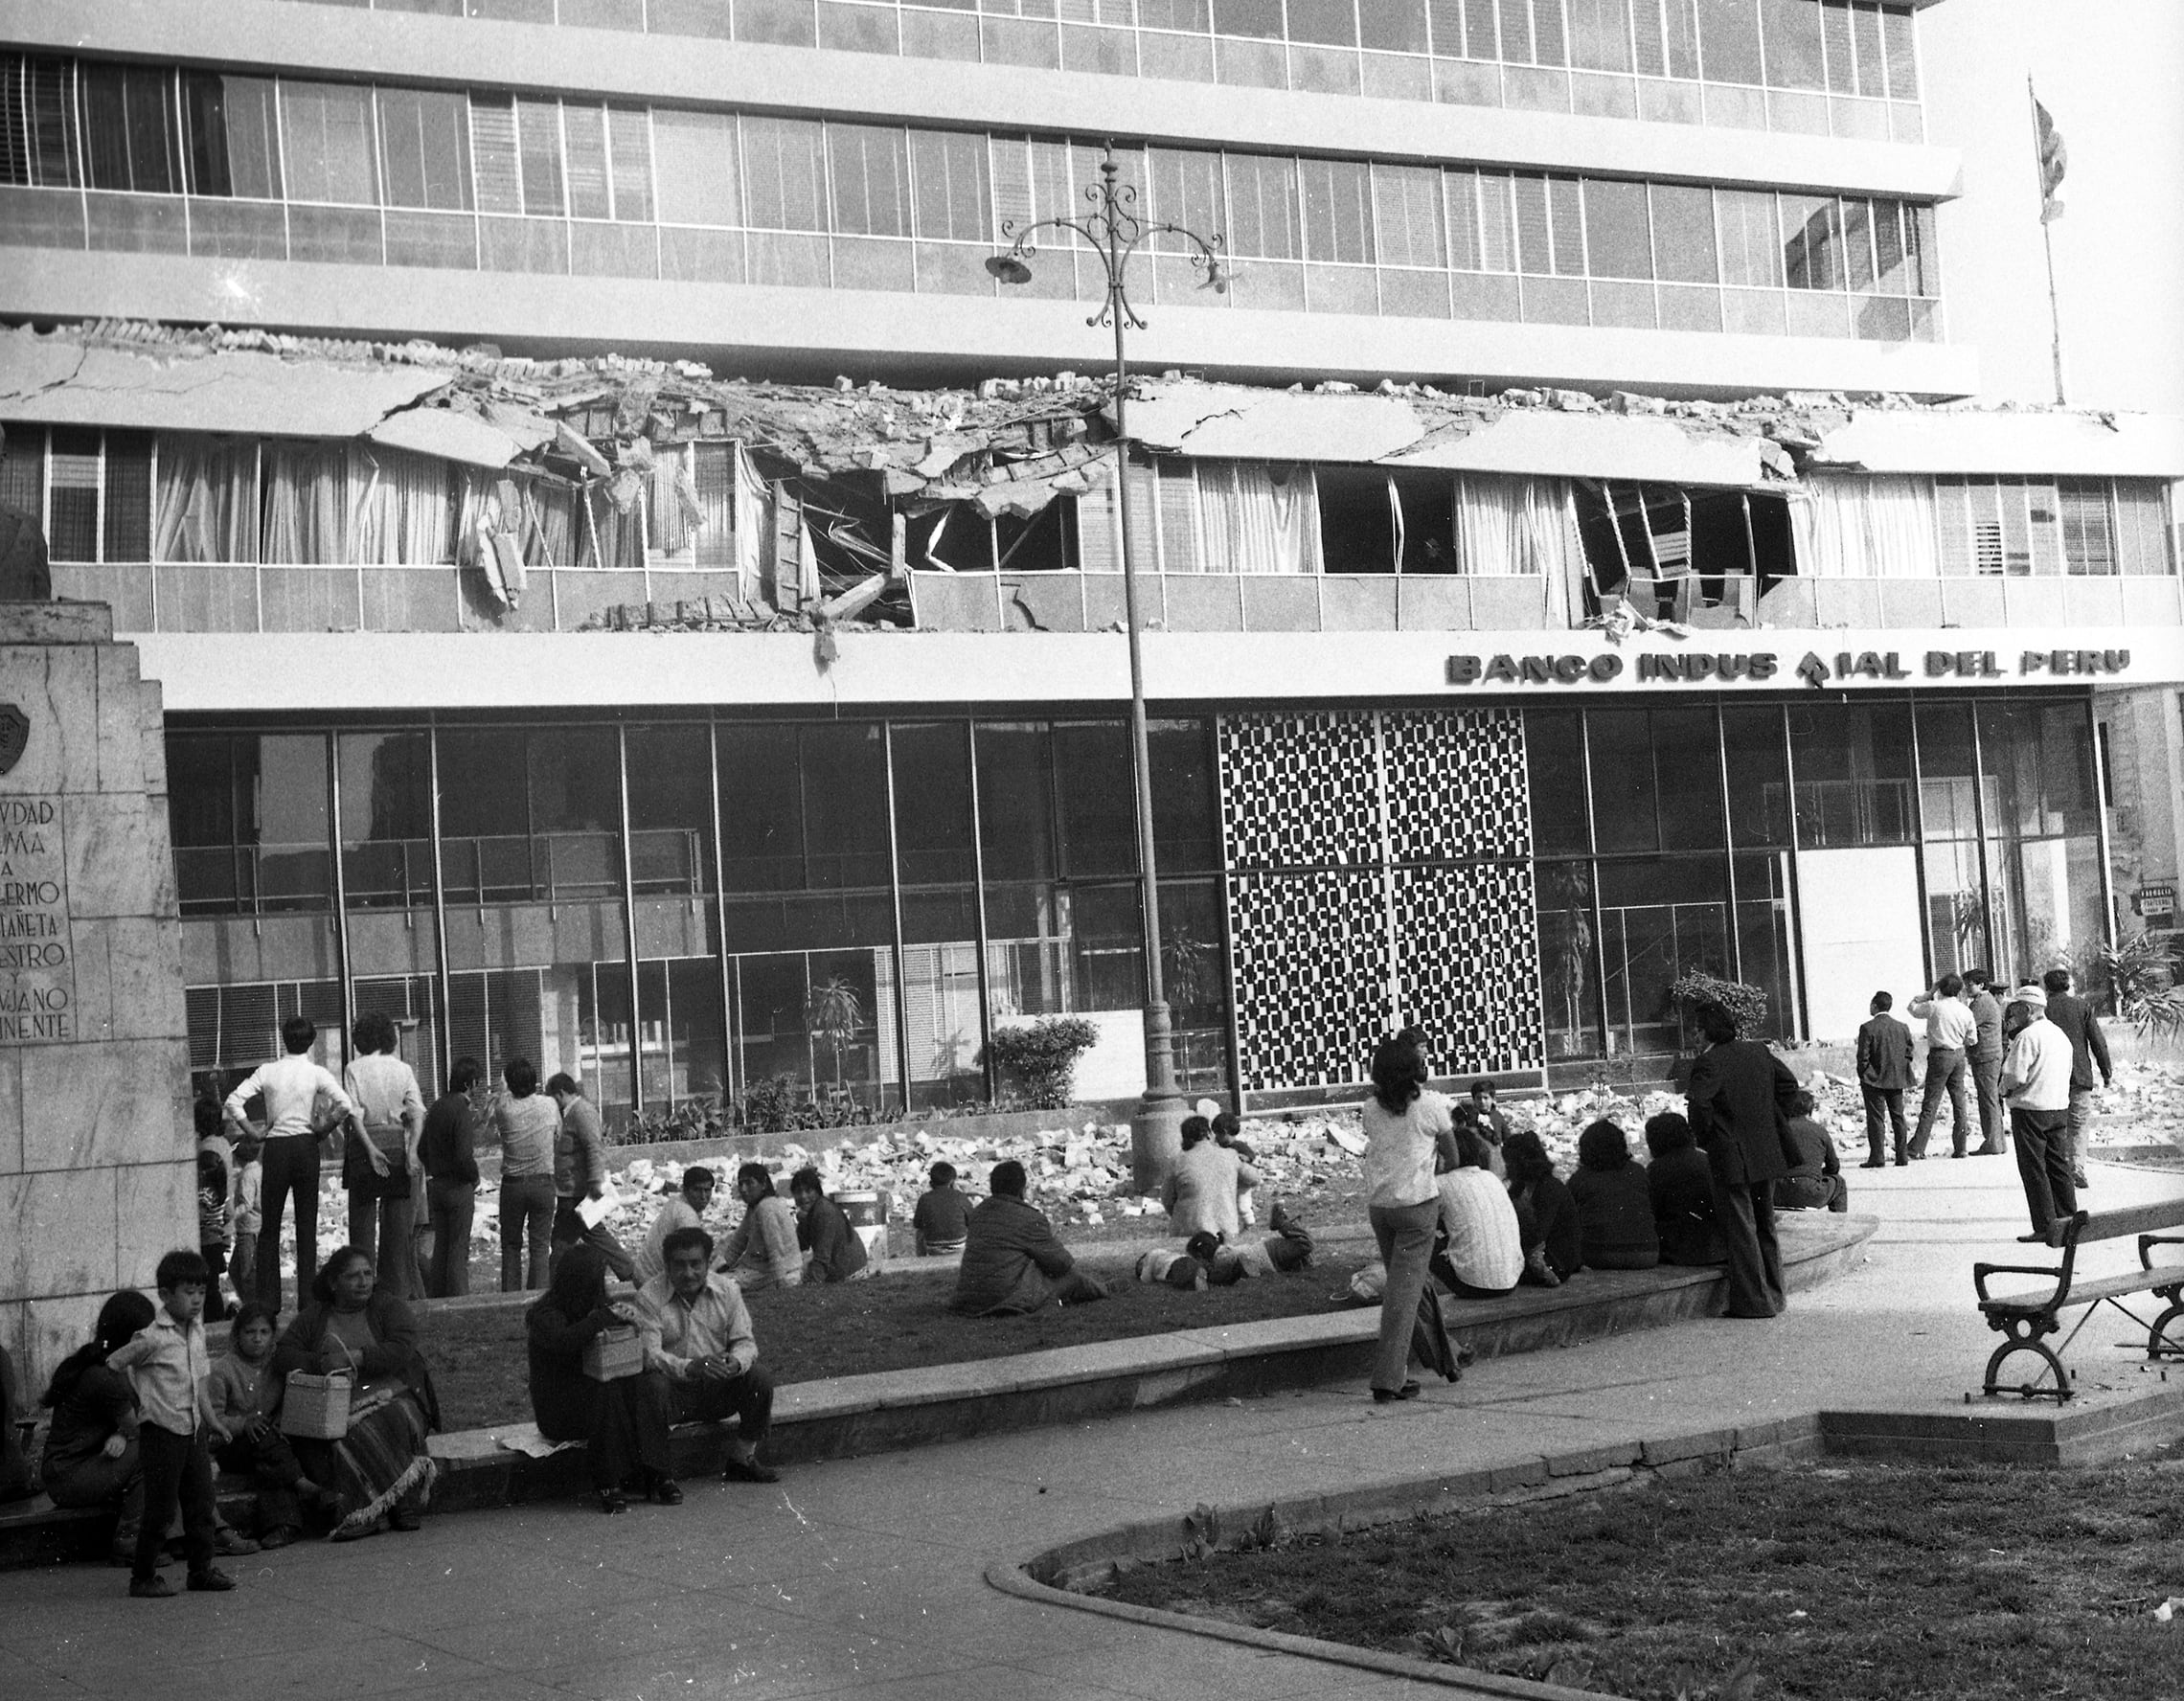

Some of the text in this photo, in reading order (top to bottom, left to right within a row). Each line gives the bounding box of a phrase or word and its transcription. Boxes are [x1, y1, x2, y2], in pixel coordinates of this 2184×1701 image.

[1445, 653, 1624, 686] BANCO
[1923, 650, 2008, 679] DEL
[2018, 649, 2130, 676] PERU
[1, 861, 13, 876] A
[11, 972, 20, 985] Y
